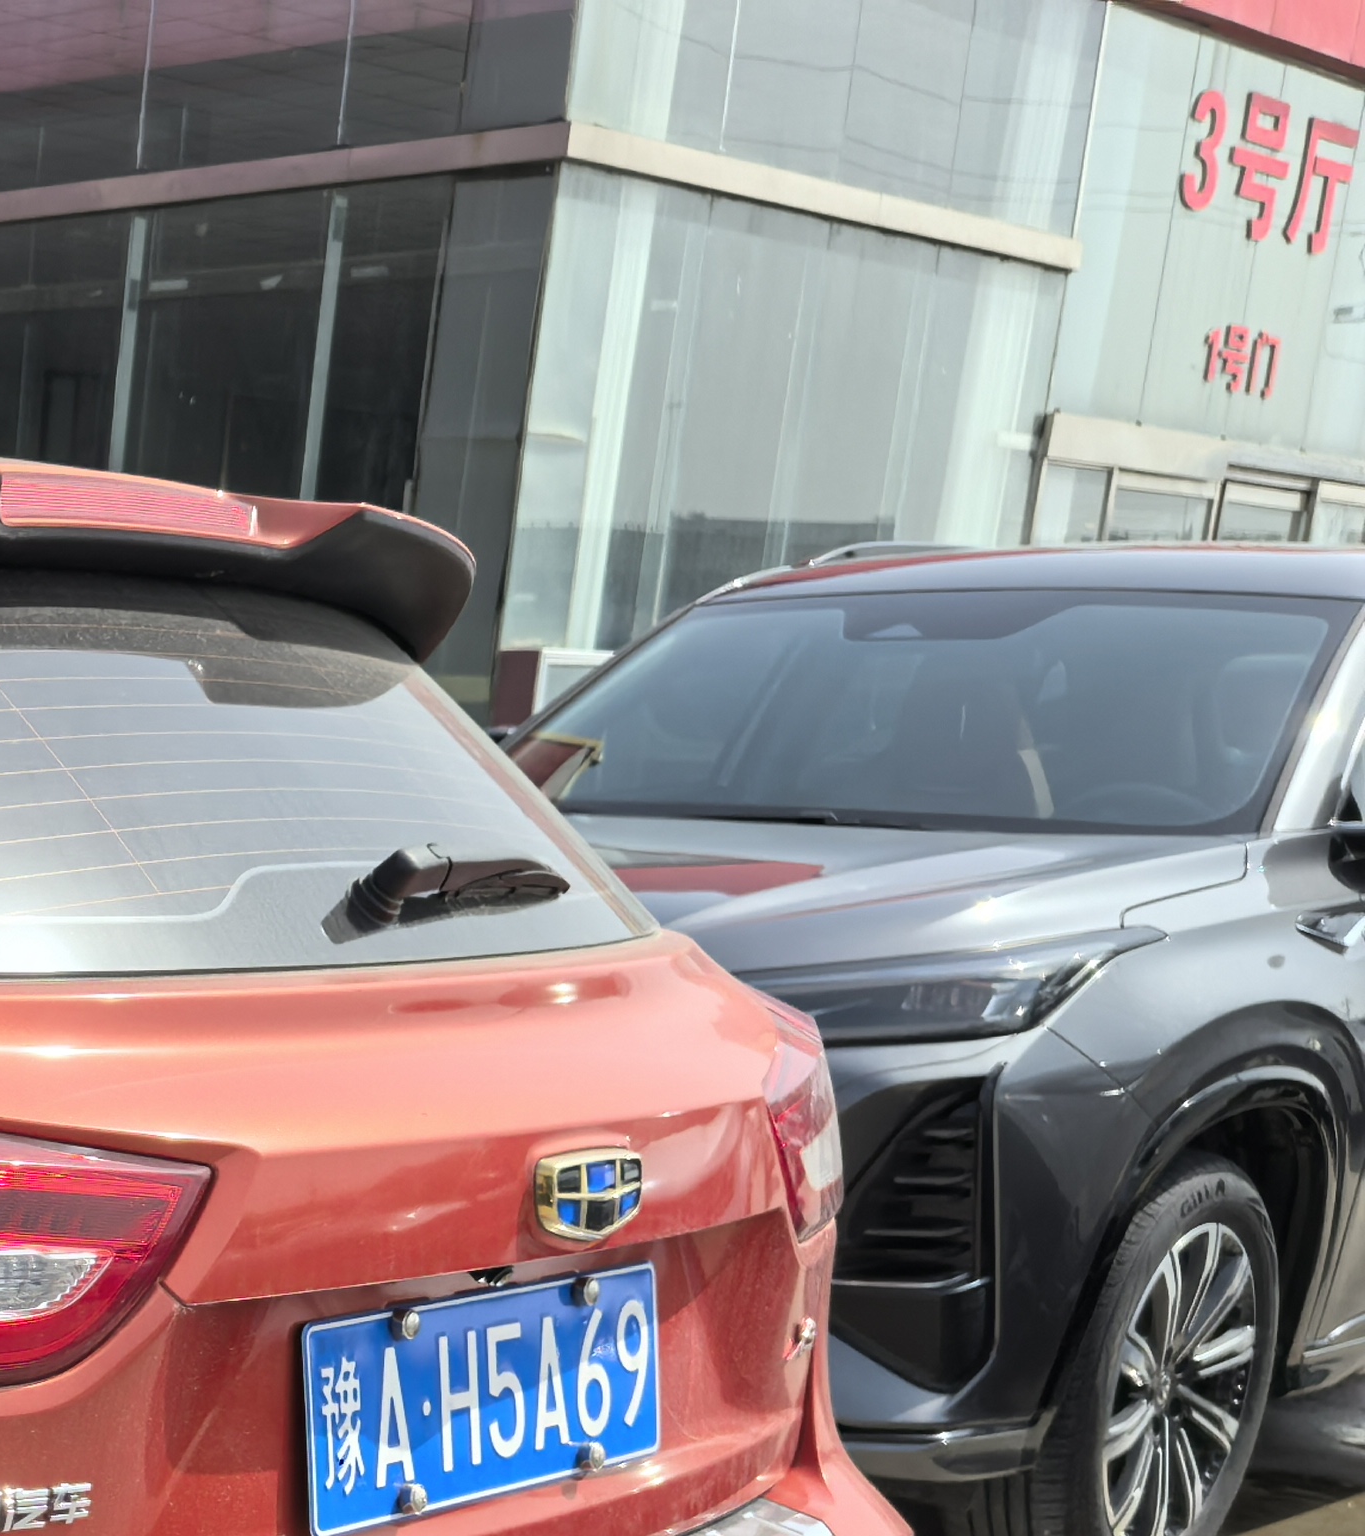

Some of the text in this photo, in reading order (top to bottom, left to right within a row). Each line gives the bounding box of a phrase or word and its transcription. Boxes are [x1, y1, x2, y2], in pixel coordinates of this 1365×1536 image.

[1179, 89, 1360, 256] 3号厅
[1203, 323, 1282, 400] 1号门
[321, 1300, 648, 1496] 豫A·H5A69
